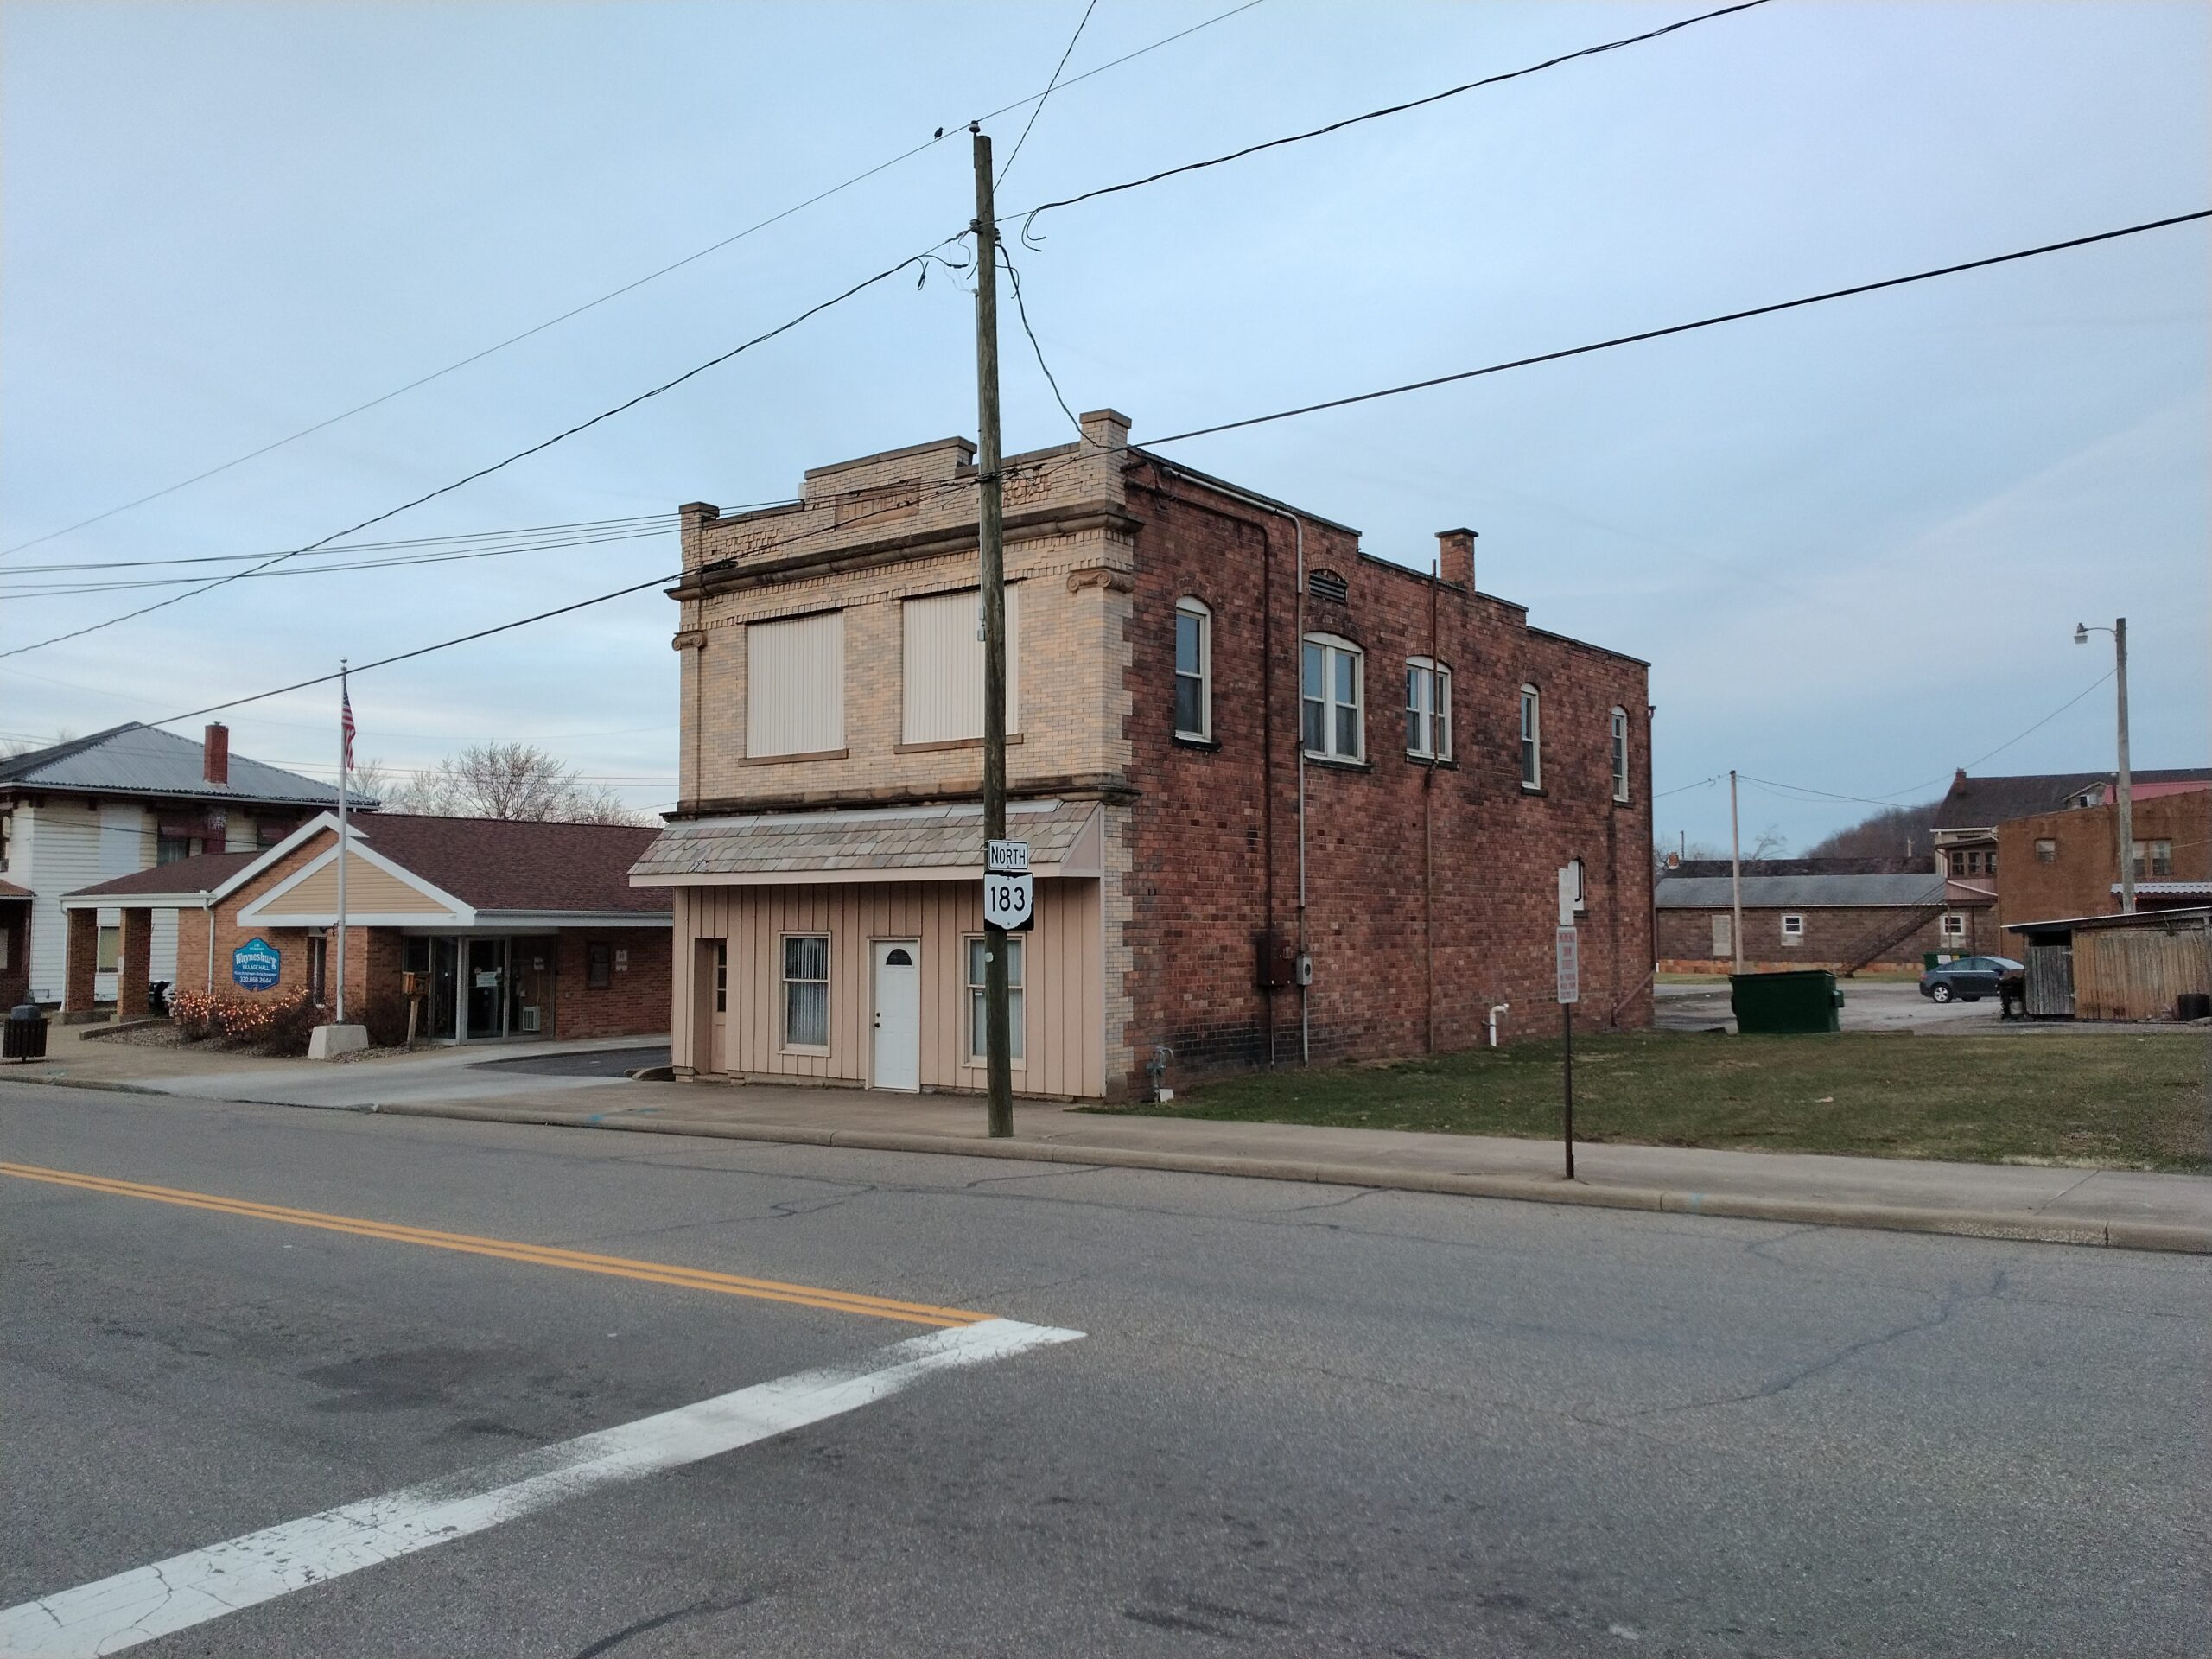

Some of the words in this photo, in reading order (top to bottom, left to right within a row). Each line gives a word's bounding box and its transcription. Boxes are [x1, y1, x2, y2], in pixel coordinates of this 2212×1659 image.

[991, 846, 1026, 864] NORTH
[990, 886, 1025, 912] 183
[236, 951, 276, 969] Waynesburg
